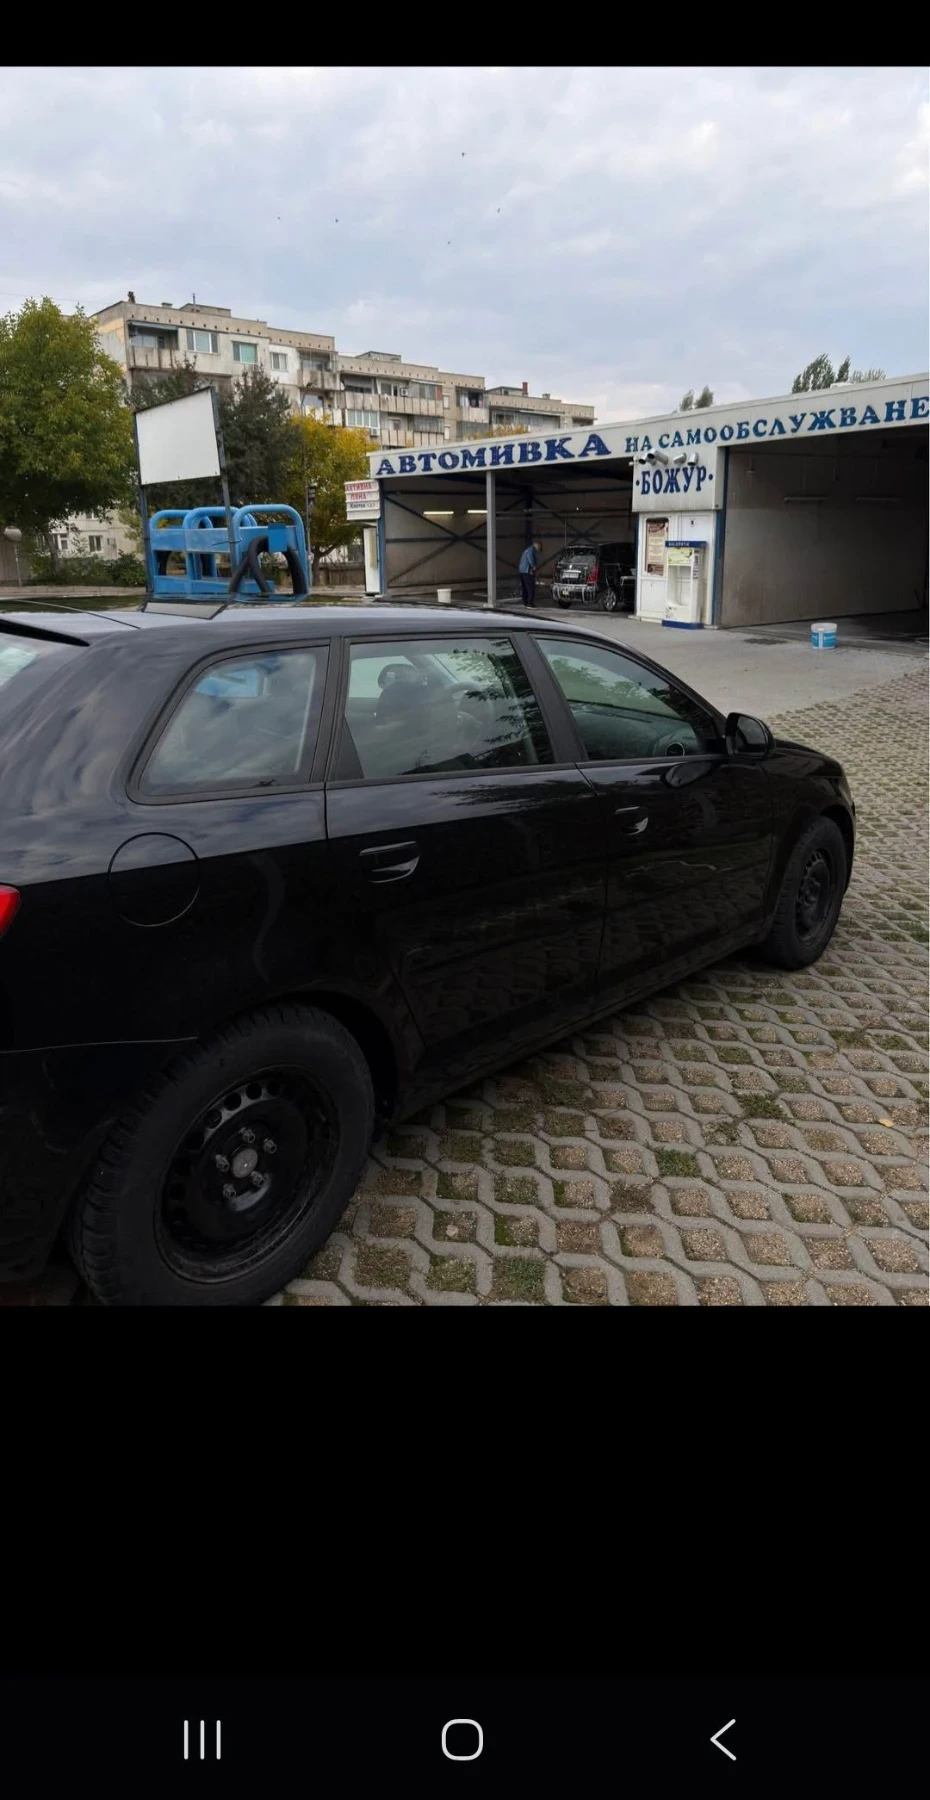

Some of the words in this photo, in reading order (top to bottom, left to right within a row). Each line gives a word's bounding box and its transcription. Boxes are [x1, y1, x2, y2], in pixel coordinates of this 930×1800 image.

[377, 434, 612, 476] АВТОМИВКА
[625, 435, 653, 453] НА
[658, 396, 929, 449] САМООБСЛУЖВАНЕ
[641, 465, 707, 495] БОЖУР
